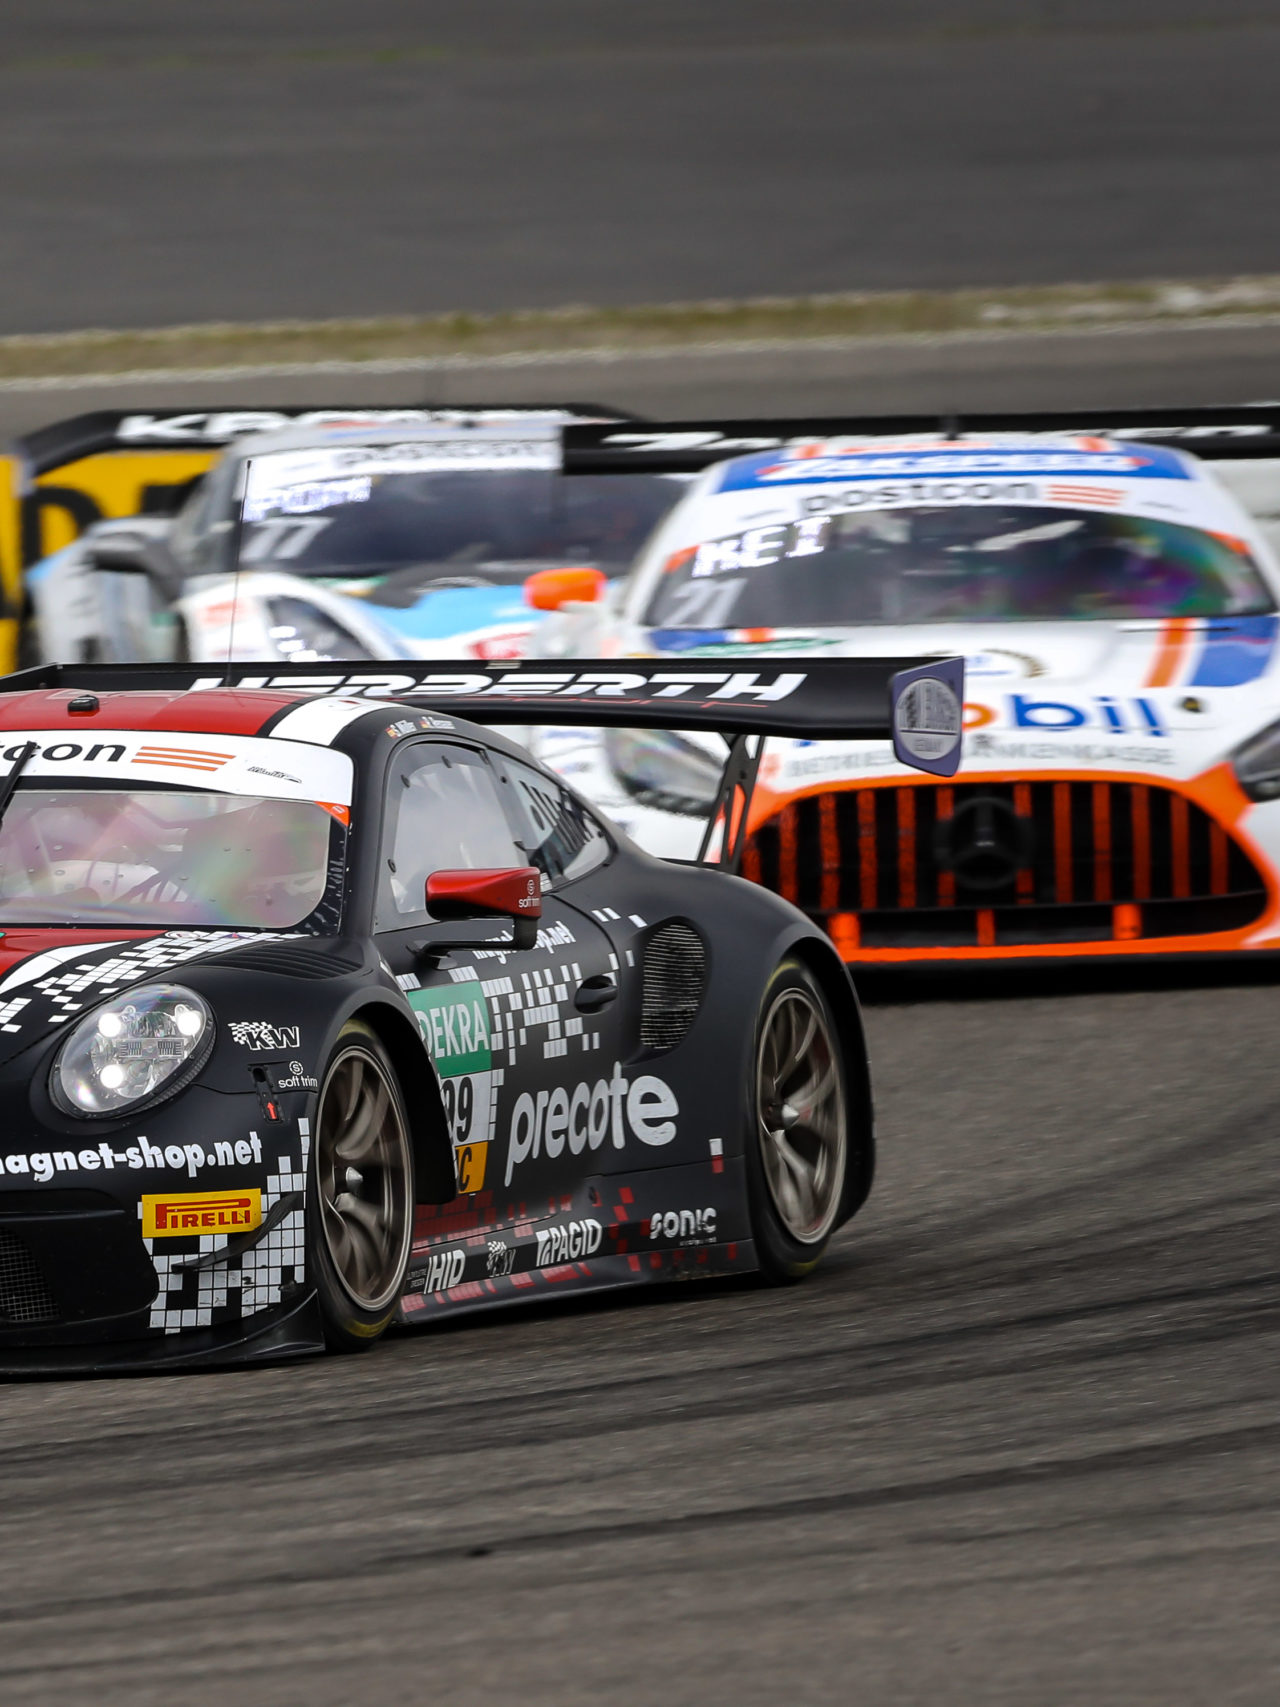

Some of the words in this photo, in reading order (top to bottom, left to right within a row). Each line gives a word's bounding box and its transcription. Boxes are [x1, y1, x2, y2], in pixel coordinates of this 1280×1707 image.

[796, 483, 1037, 516] postcon
[188, 673, 808, 700] HERBERTH
[963, 694, 1167, 737] obil
[244, 1026, 300, 1051] KW
[278, 1076, 300, 1088] soft
[301, 1075, 318, 1087] trim
[504, 1061, 679, 1187] precote
[155, 1198, 251, 1230] PIRELLI
[549, 1219, 602, 1263] PAGID
[427, 1250, 465, 1294] HID
